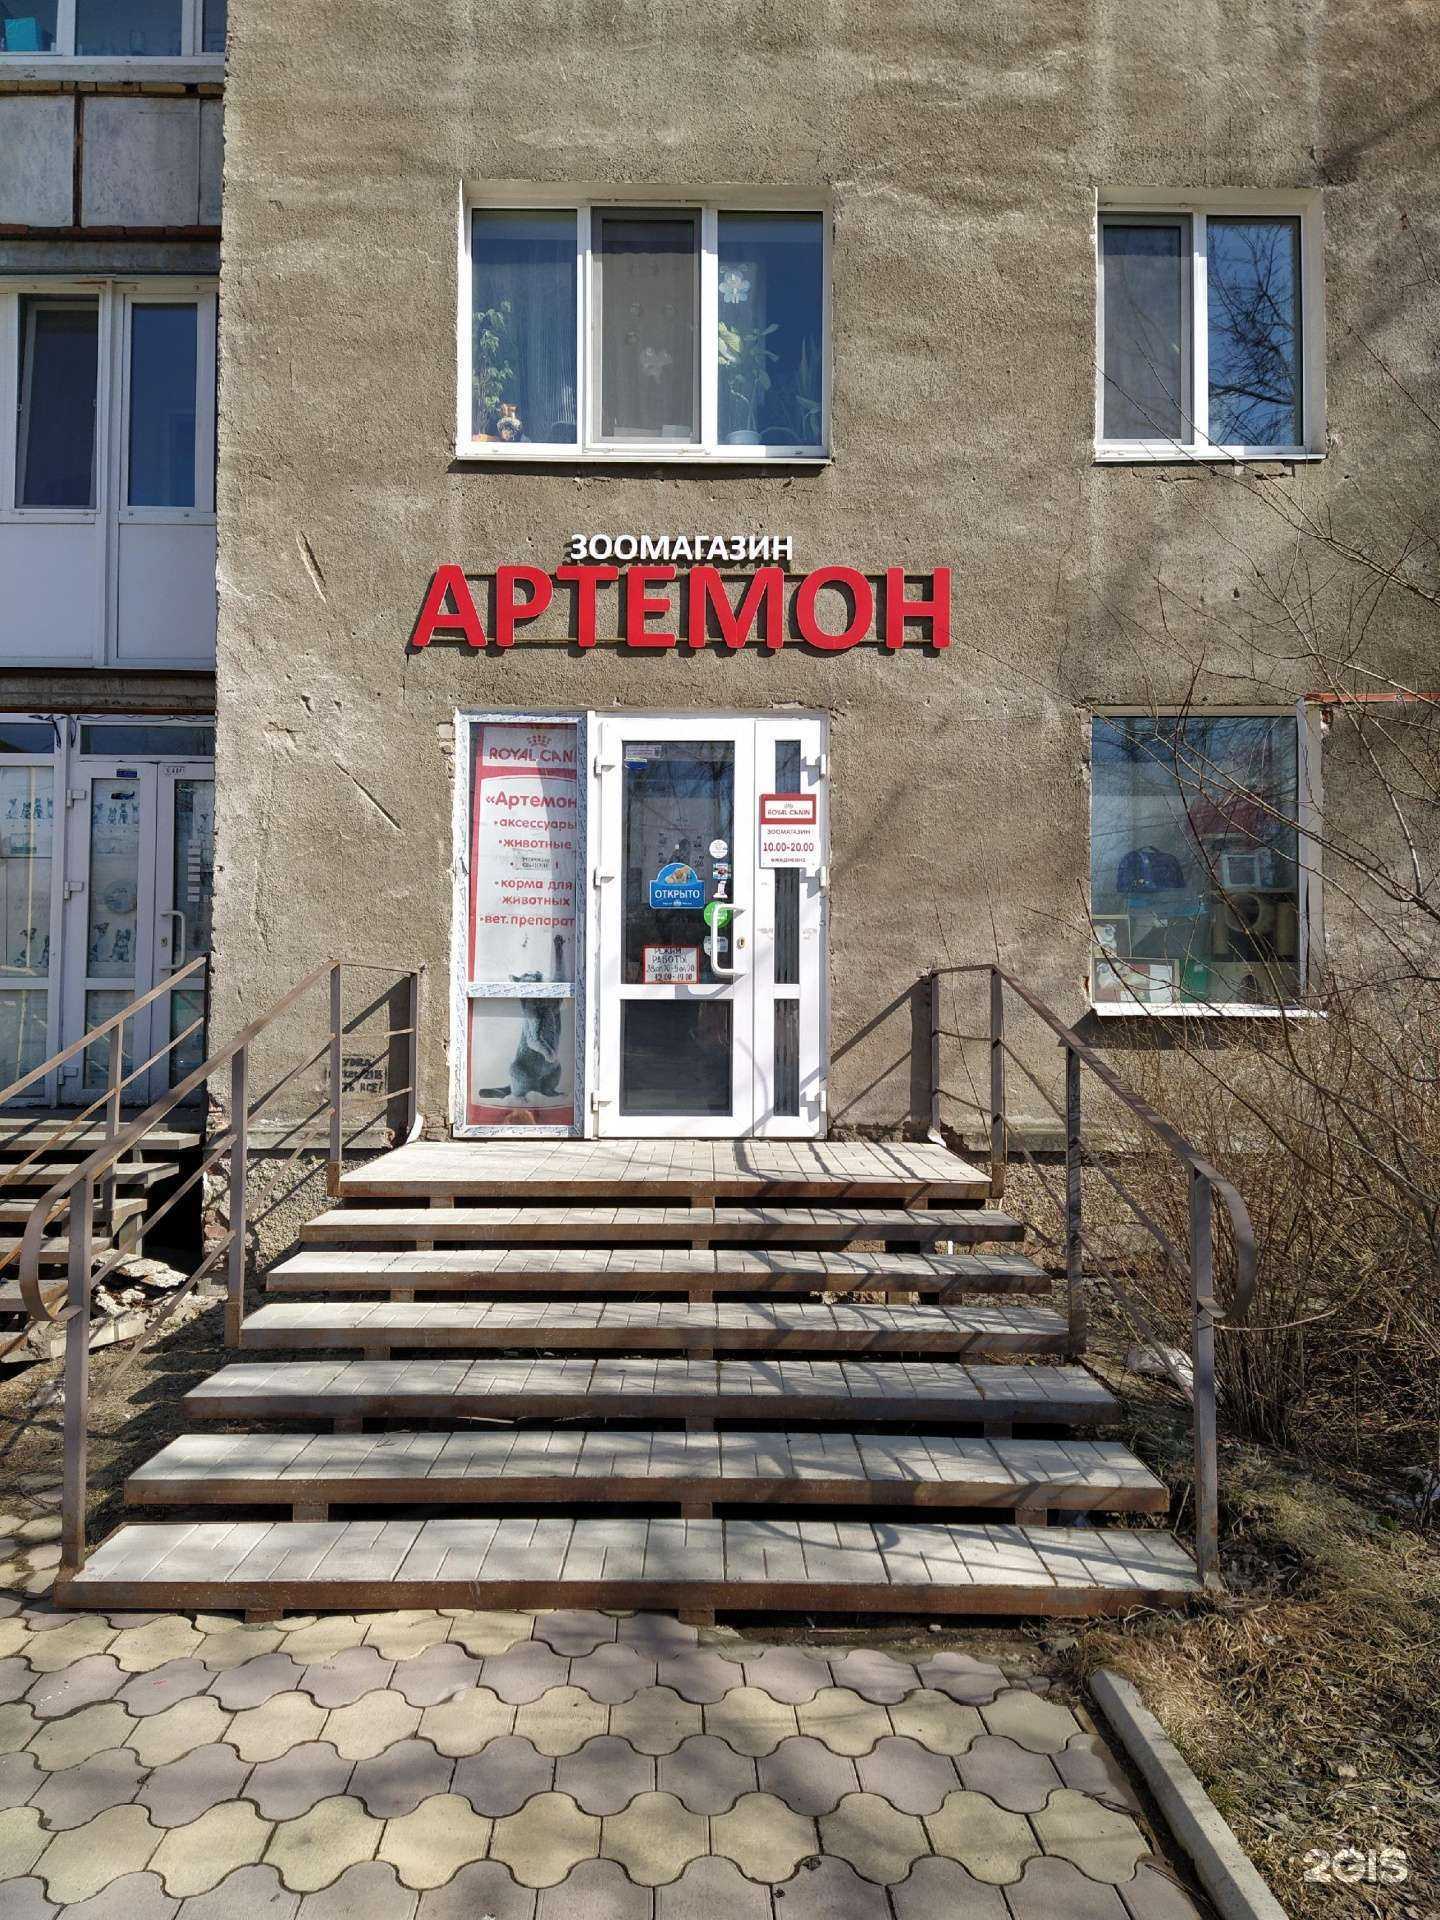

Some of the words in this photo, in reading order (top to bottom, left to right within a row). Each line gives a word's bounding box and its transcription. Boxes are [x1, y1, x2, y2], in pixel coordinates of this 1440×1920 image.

[570, 533, 793, 562] ЗООМАГАЗИН
[411, 564, 951, 651] АРТЕМОН
[489, 747, 536, 762] ROYAL
[503, 839, 572, 850] животные
[763, 842, 815, 852] 10.00-20.00
[501, 880, 544, 891] корма
[548, 881, 573, 892] для
[654, 889, 700, 899] ОТКРЫТО
[502, 896, 571, 907] животных
